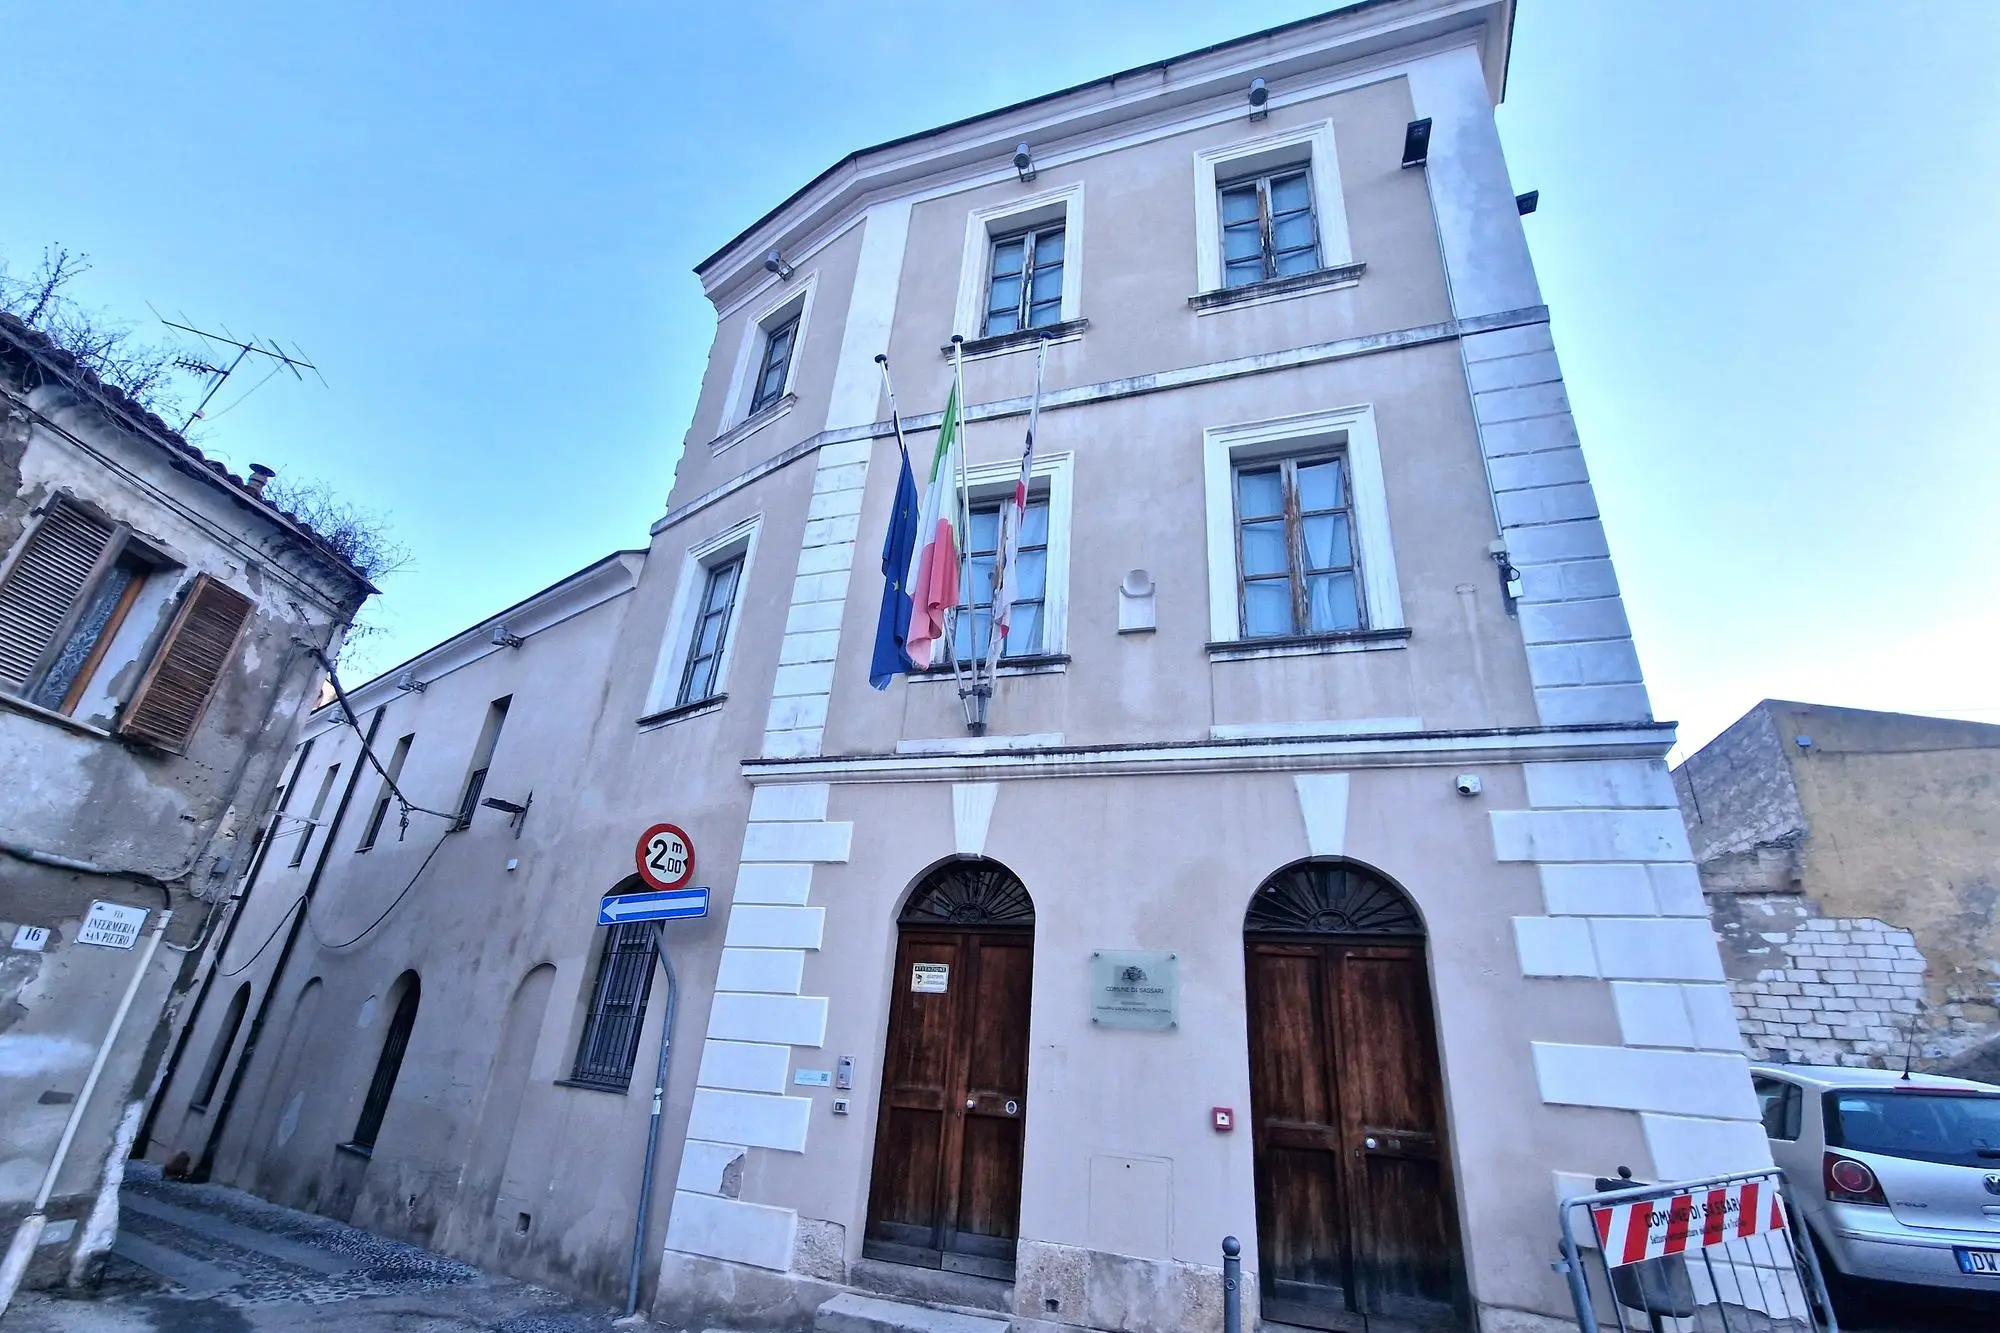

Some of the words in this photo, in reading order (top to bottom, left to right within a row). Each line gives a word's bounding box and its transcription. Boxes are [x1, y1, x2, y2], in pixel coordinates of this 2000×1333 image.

[113, 910, 124, 919] VIA
[88, 918, 136, 934] INFERMERIA
[24, 928, 41, 942] 16
[85, 930, 101, 940] SAN
[102, 932, 130, 946] PIETRO
[1105, 985, 1130, 993] COMUNE
[1139, 986, 1164, 994] SASSARI
[1895, 1201, 1928, 1209] POLO
[1643, 1207, 1690, 1228] COMUNE
[1690, 1204, 1701, 1220] DI
[1701, 1197, 1743, 1218] SASSARI
